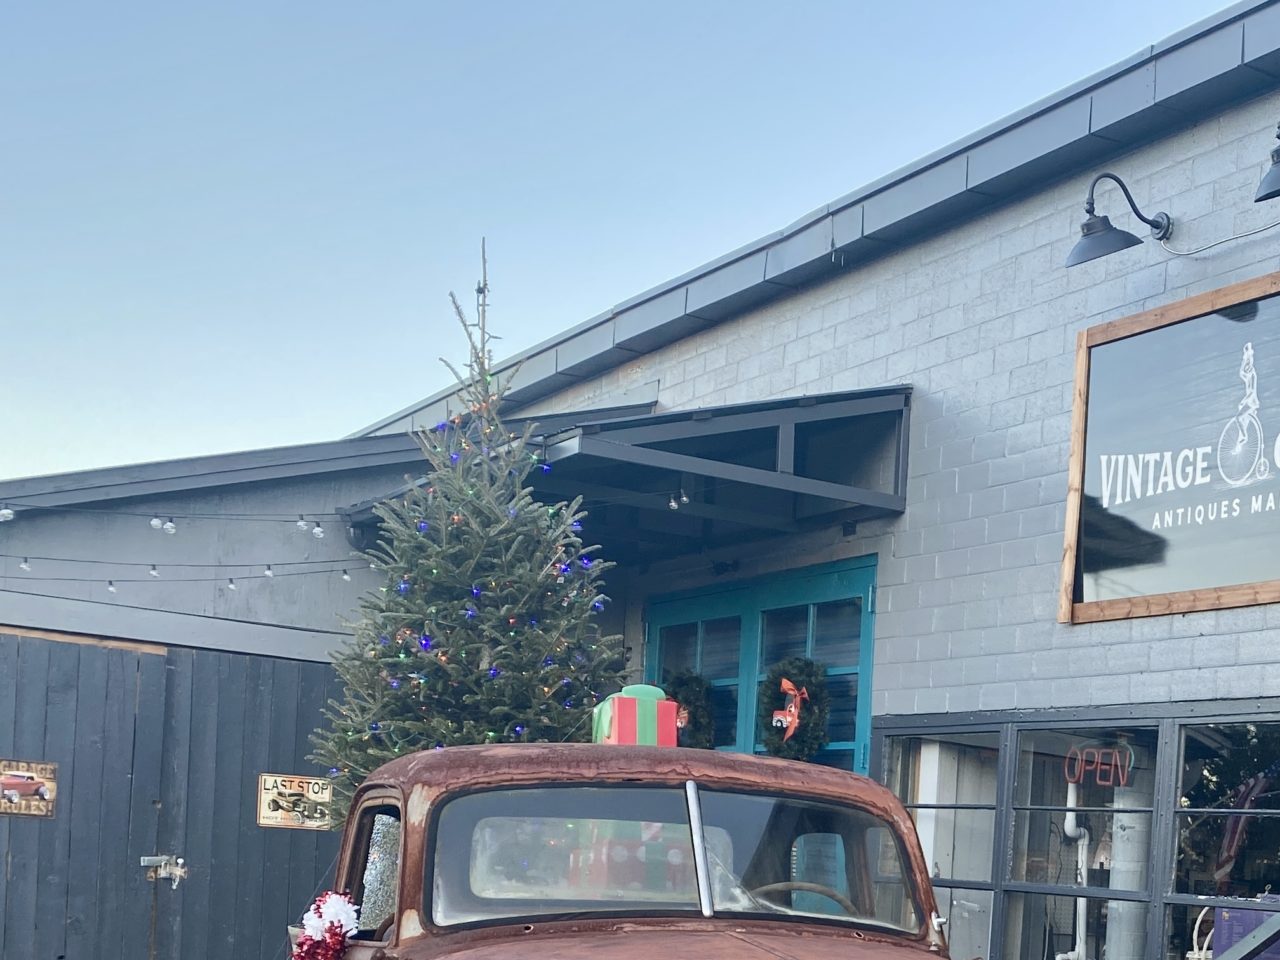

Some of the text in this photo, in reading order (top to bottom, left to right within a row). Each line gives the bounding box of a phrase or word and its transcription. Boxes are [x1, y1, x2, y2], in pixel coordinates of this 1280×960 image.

[1100, 446, 1212, 509] VINTAGE
[1151, 498, 1241, 530] ANTIQUES
[1064, 746, 1130, 786] OPEN
[263, 778, 329, 795] LAST STOP
